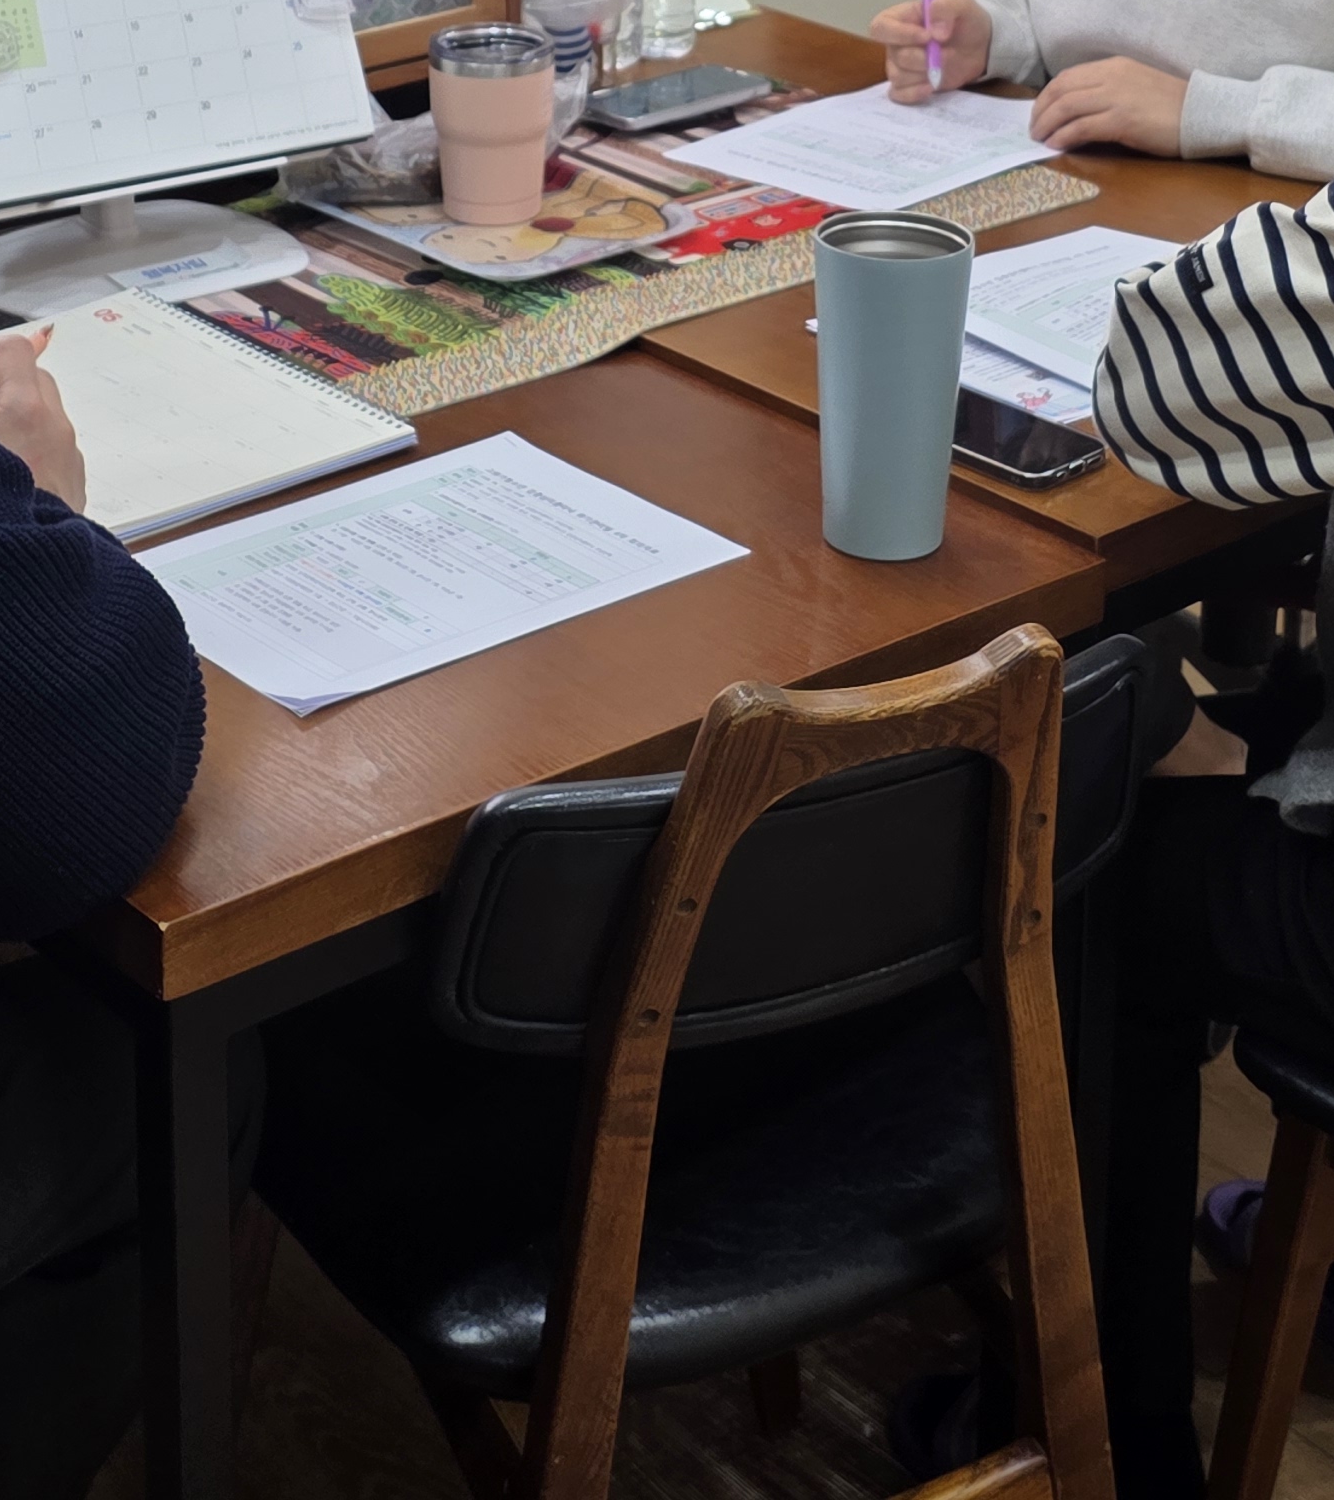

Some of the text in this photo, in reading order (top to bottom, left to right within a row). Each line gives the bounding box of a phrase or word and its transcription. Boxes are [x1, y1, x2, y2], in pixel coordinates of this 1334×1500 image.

[74, 29, 84, 39] 14
[243, 48, 253, 59] 24
[192, 56, 202, 67] 23
[82, 74, 92, 84] 21
[25, 83, 36, 94] 20
[146, 110, 157, 121] 29
[34, 128, 45, 139] 27
[93, 307, 123, 323] 05
